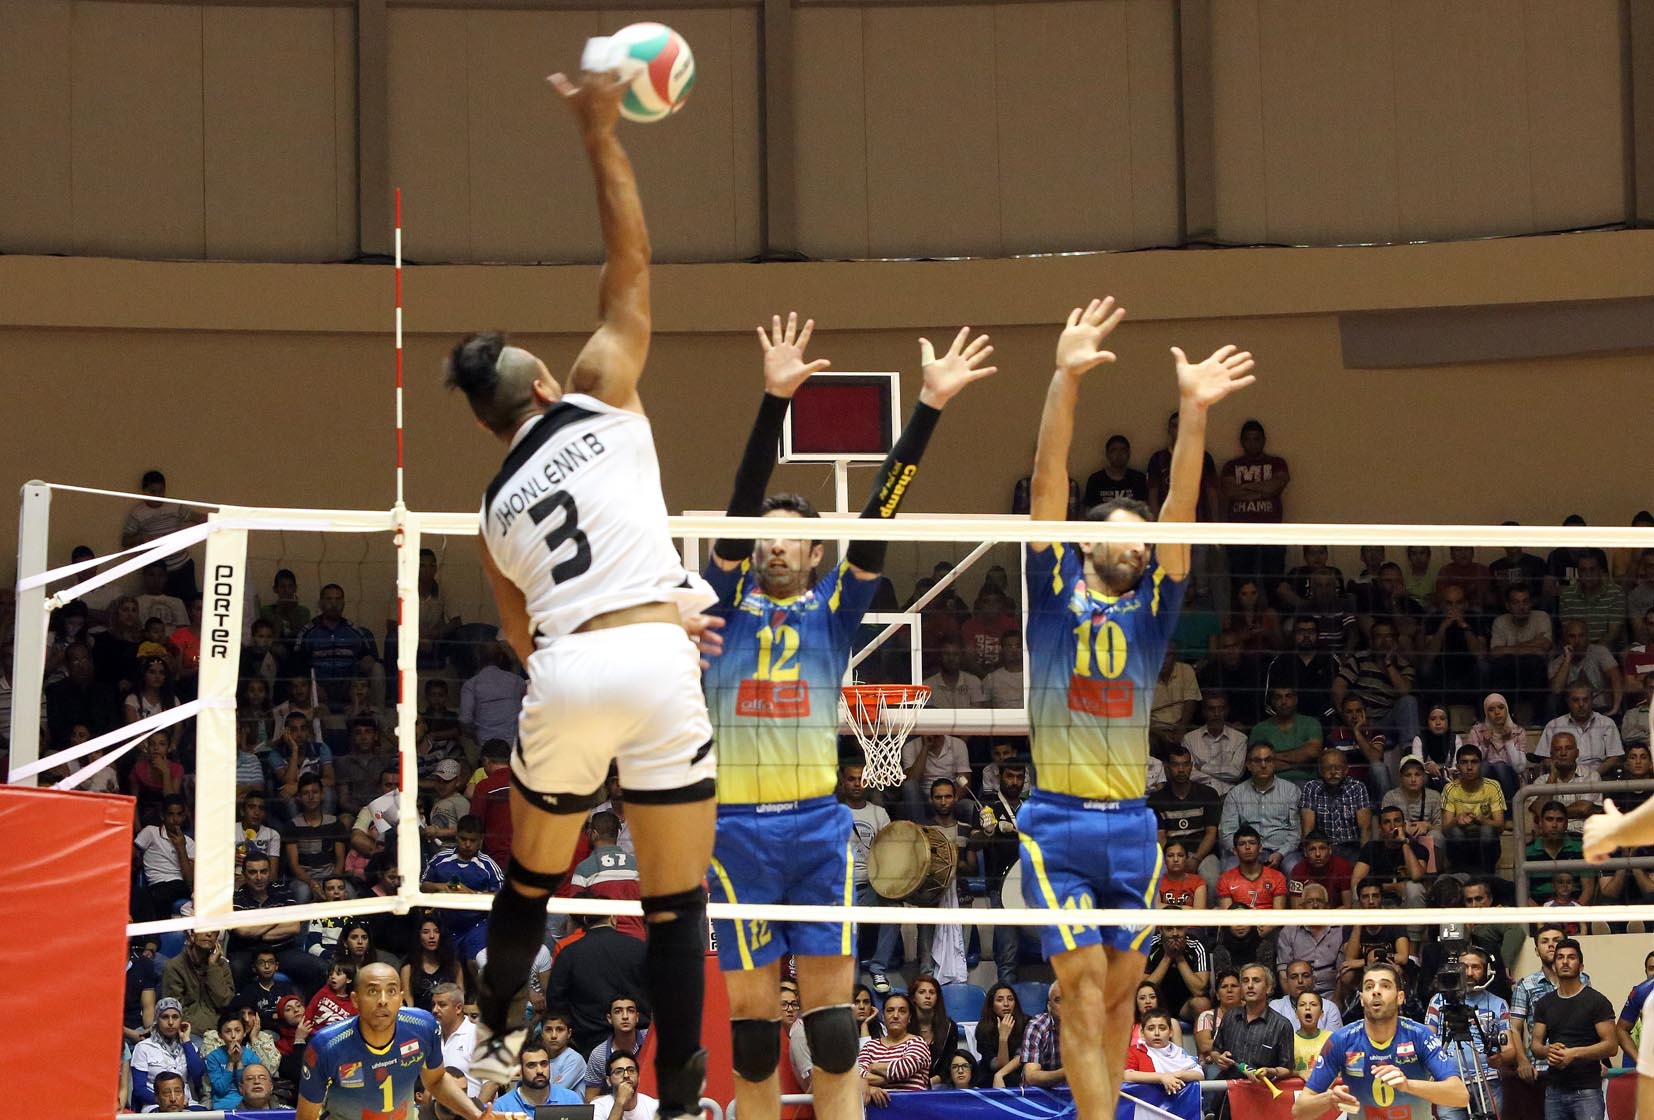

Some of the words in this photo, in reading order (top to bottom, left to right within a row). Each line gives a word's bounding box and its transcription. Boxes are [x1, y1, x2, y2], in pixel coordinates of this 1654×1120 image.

[880, 464, 917, 518] Champ
[527, 489, 592, 586] 3
[752, 624, 801, 682] 12
[1073, 619, 1128, 680] 10
[371, 1058, 398, 1070] uhlsport
[379, 1075, 395, 1112] 1
